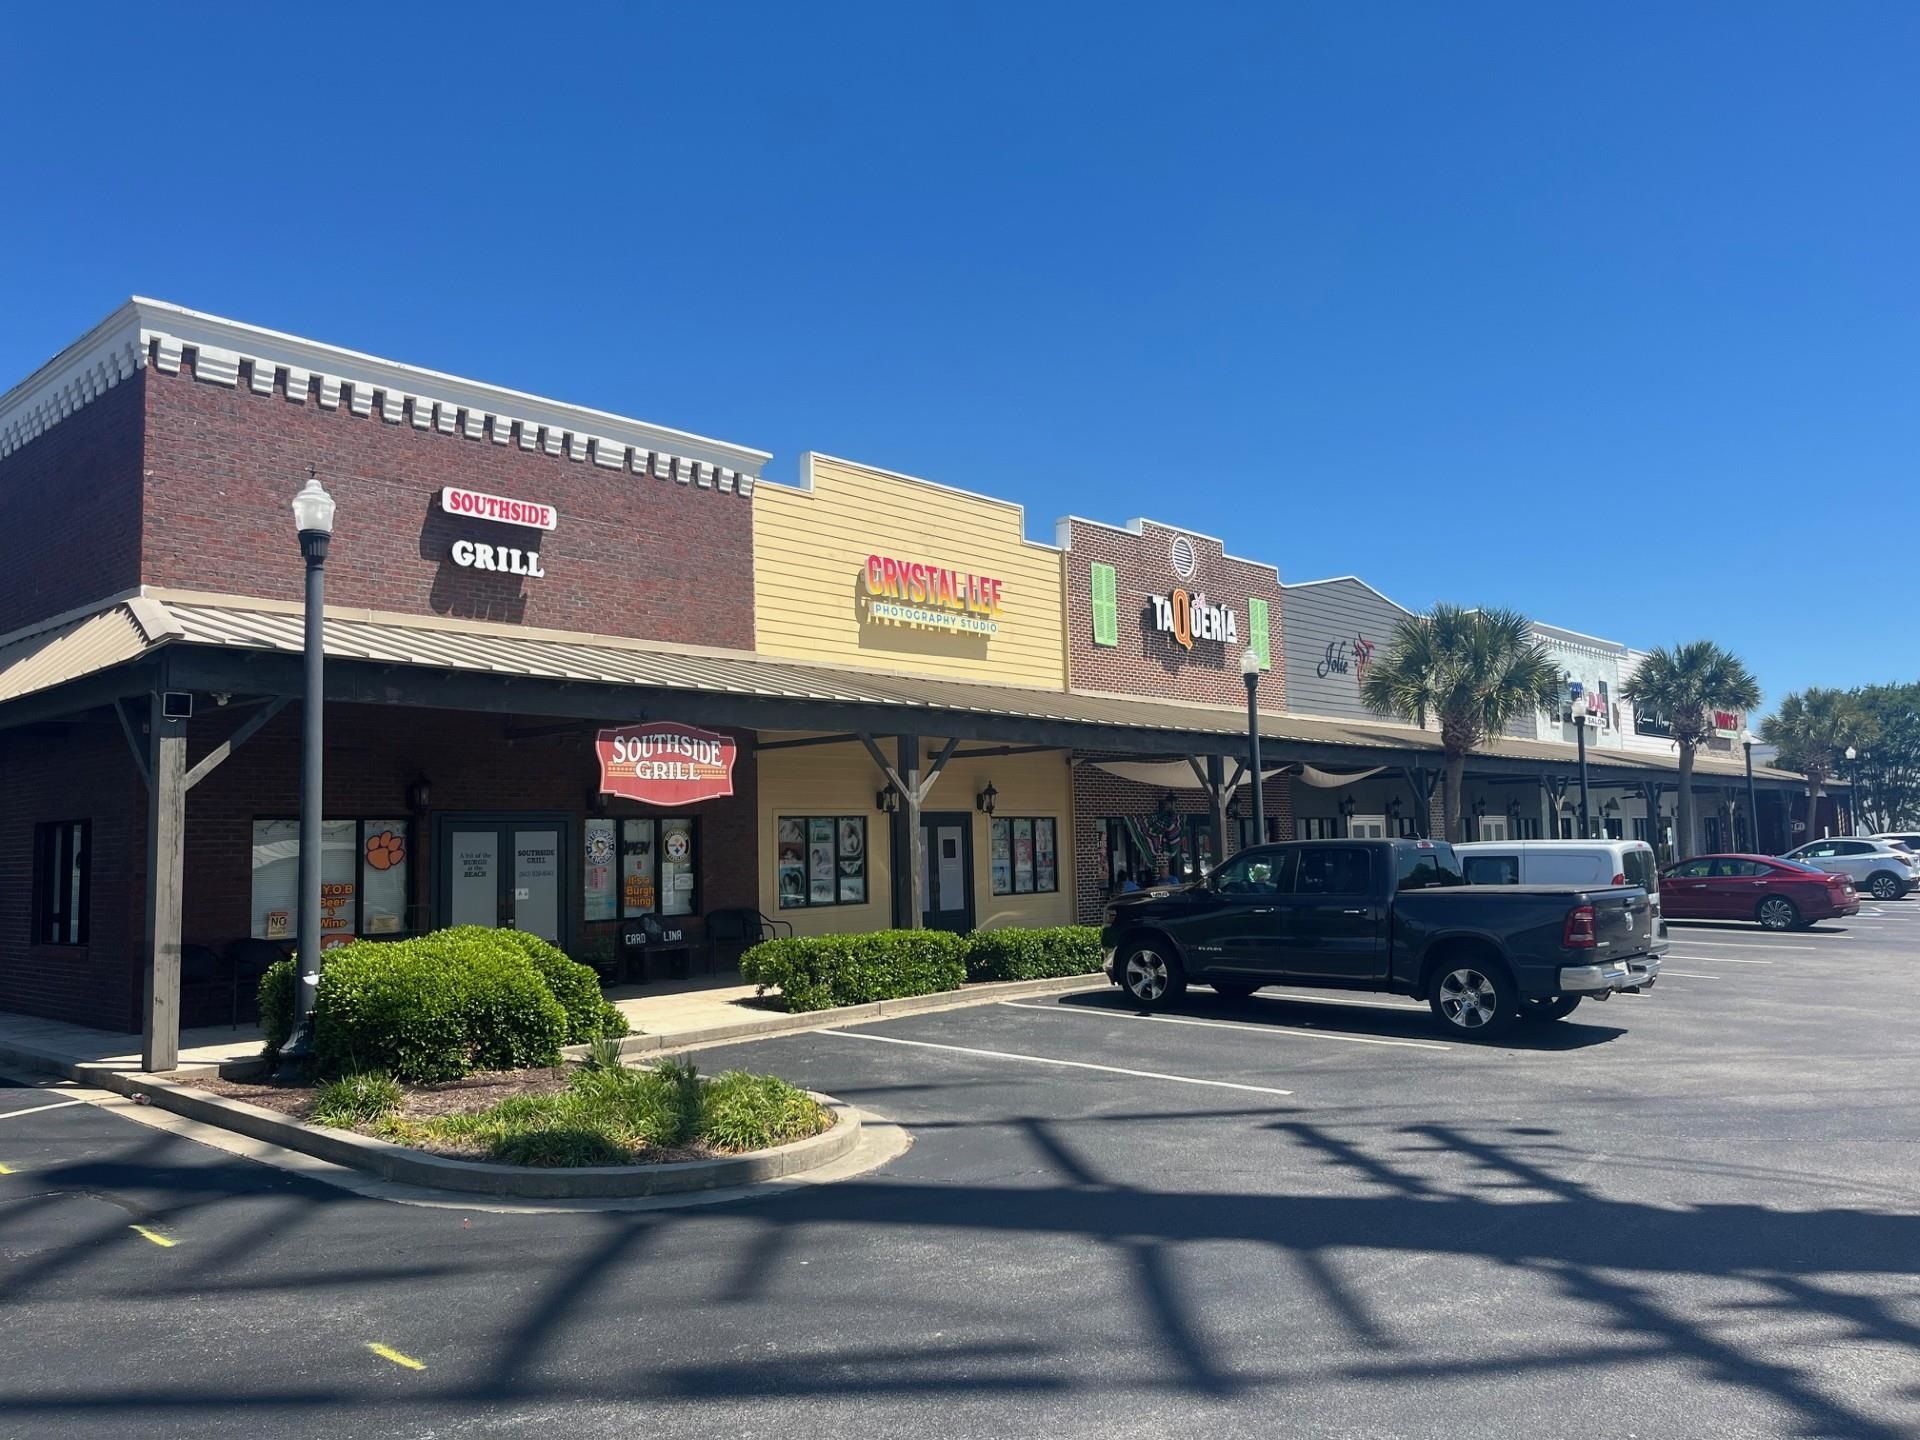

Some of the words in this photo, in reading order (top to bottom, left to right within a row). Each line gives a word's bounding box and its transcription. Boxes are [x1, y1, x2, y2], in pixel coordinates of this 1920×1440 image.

[449, 491, 550, 527] SOUTHSIDE
[452, 540, 545, 577] GRILL
[865, 554, 964, 610] CRYSTAL
[965, 573, 1004, 617] LEE
[875, 603, 956, 626] PHOTOGRAPHY
[960, 618, 997, 633] STUDIO
[1316, 640, 1348, 678] Jolie
[1587, 717, 1606, 726] SALON
[612, 734, 723, 767] SOUTHSIDE
[635, 761, 701, 780] GRILL
[322, 883, 353, 896] Y.O.B
[271, 916, 287, 926] NO
